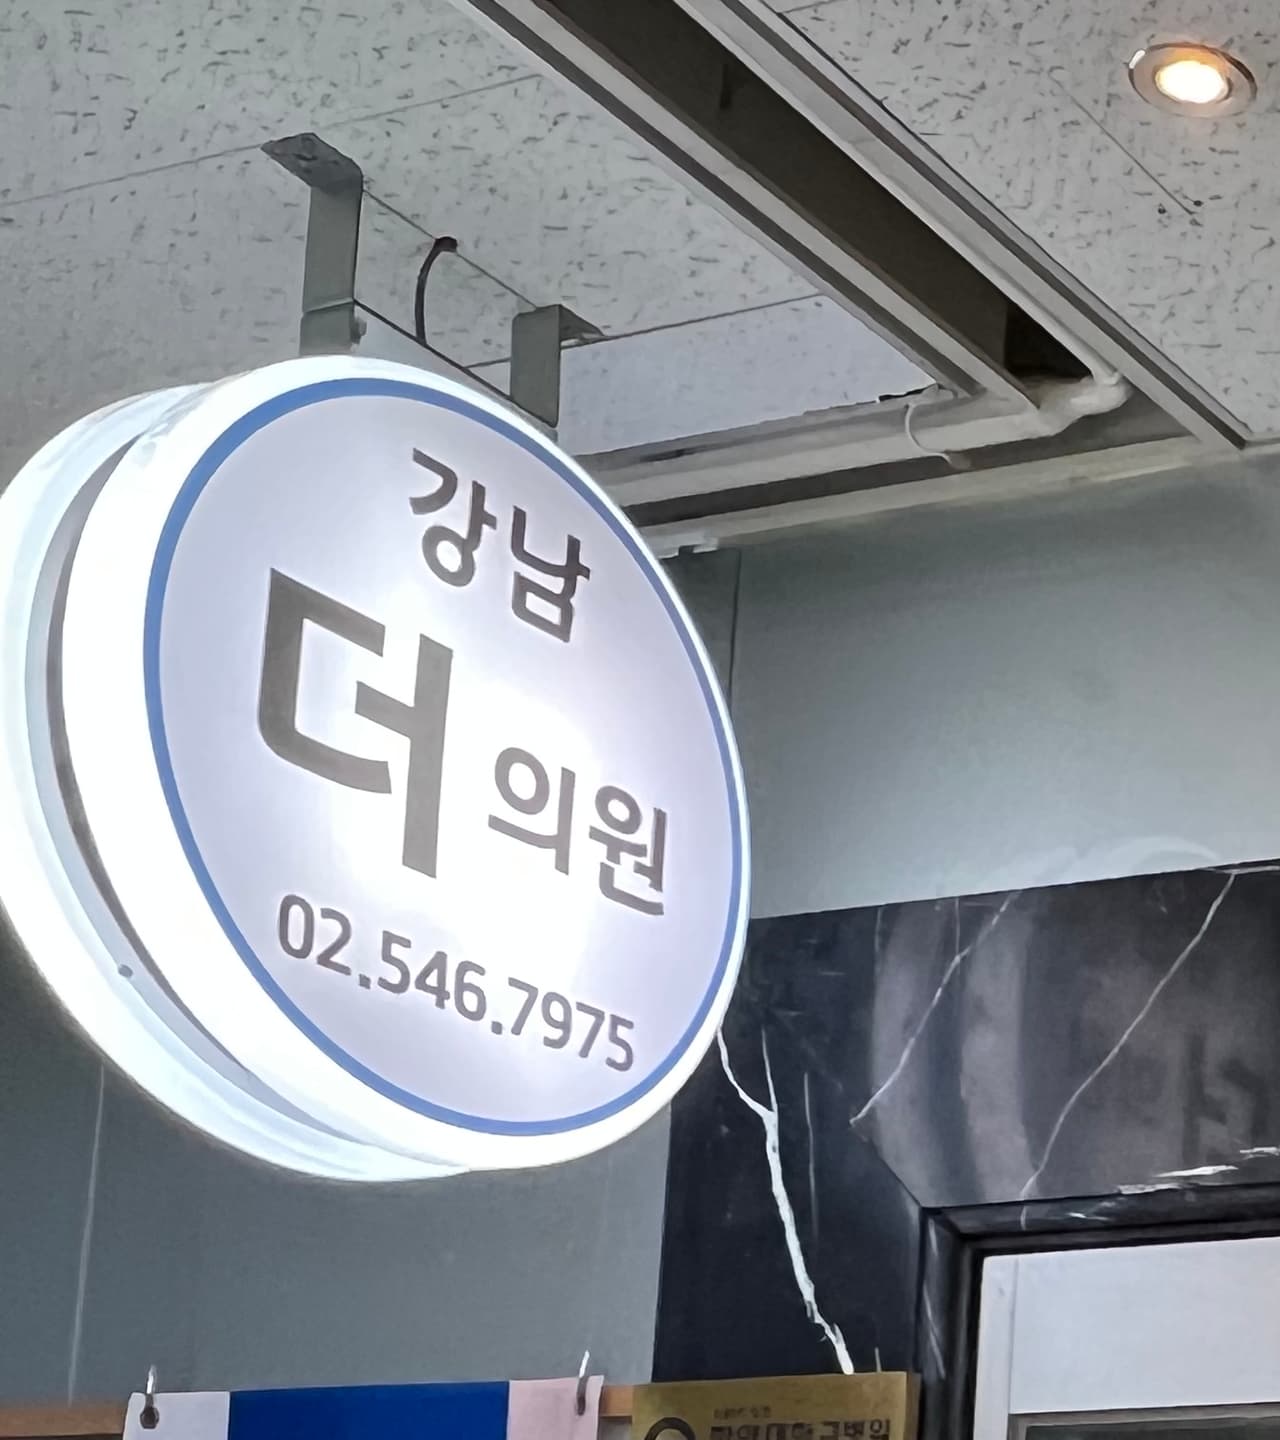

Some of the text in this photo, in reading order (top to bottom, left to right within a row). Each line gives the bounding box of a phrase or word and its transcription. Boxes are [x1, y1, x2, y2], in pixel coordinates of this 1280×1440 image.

[409, 447, 591, 644] 강남
[258, 567, 667, 916] 더 의원
[278, 893, 636, 1073] 02.546.7975
